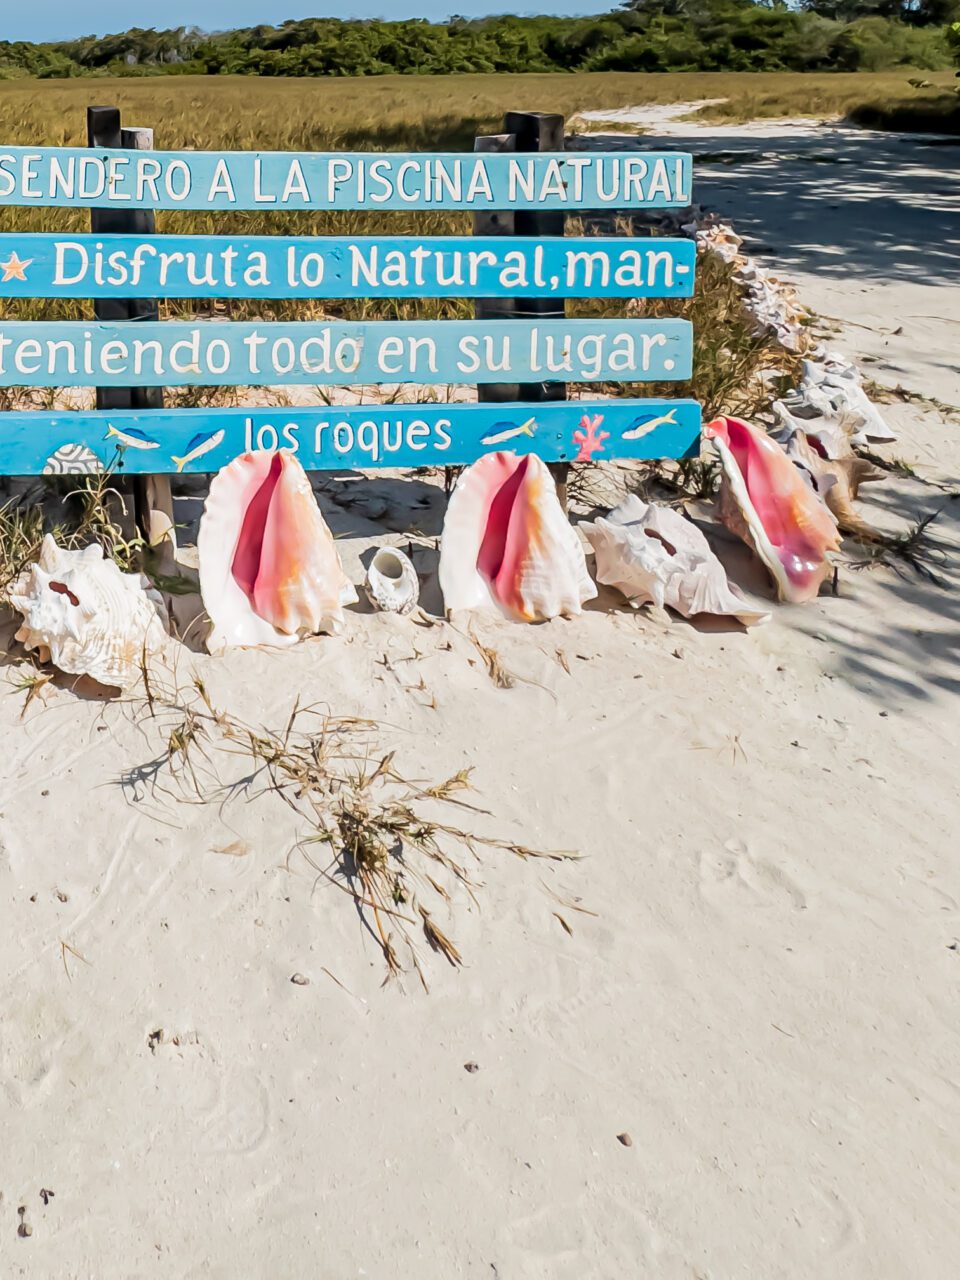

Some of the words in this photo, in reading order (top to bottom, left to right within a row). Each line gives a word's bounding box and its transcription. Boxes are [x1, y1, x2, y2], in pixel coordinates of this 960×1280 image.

[207, 158, 237, 203] A
[253, 159, 312, 203] LA
[327, 159, 493, 203] PISCINA
[508, 158, 689, 203] NATURAL
[52, 241, 271, 287] Disfruta
[287, 245, 324, 288] lo
[243, 327, 362, 375] todo
[378, 336, 439, 373] en
[456, 334, 512, 372] su
[531, 327, 675, 379] lugar.
[244, 417, 299, 454] los
[314, 418, 452, 462] roques
